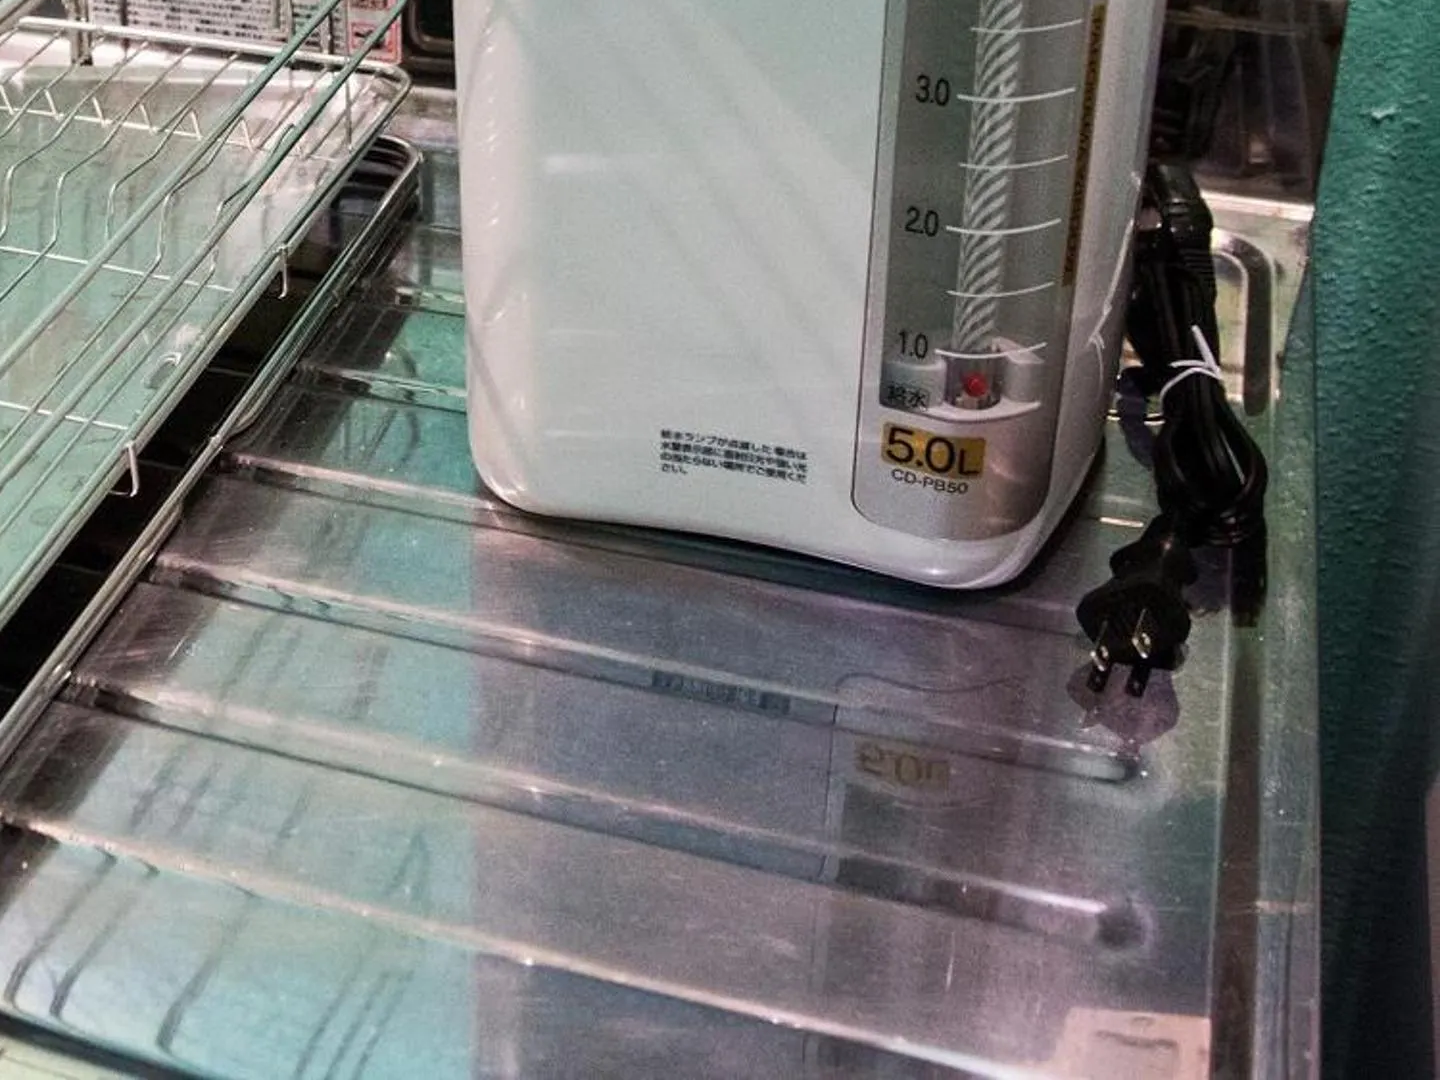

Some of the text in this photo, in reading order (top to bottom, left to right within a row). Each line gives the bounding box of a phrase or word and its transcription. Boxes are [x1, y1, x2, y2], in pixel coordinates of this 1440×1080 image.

[915, 74, 951, 107] 3.0
[904, 206, 939, 237] 2.0
[898, 331, 929, 359] 1.0
[886, 427, 981, 475] 5.0L
[891, 468, 969, 494] CD-PB50
